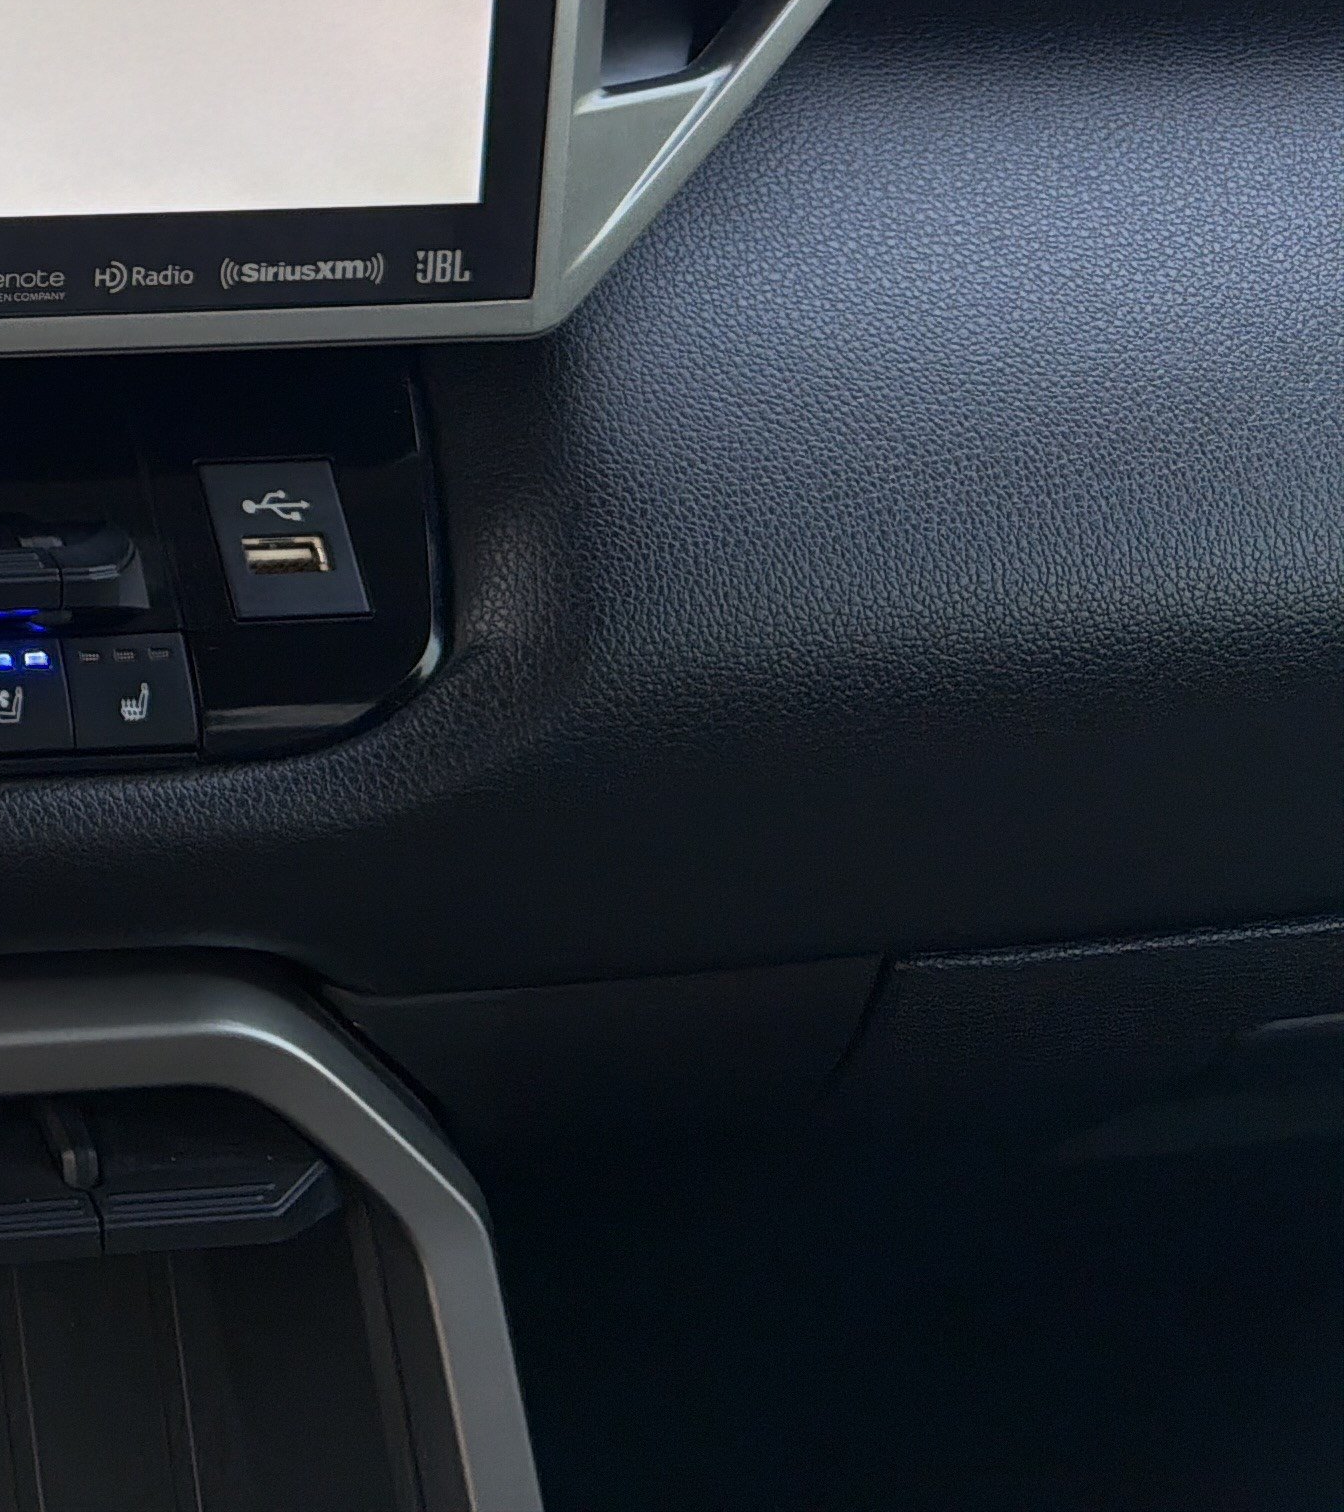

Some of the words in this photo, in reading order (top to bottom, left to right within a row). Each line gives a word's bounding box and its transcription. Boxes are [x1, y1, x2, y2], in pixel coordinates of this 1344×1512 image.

[131, 264, 194, 287] Radio
[415, 249, 471, 285] JBL
[13, 291, 66, 302] COMPANY
